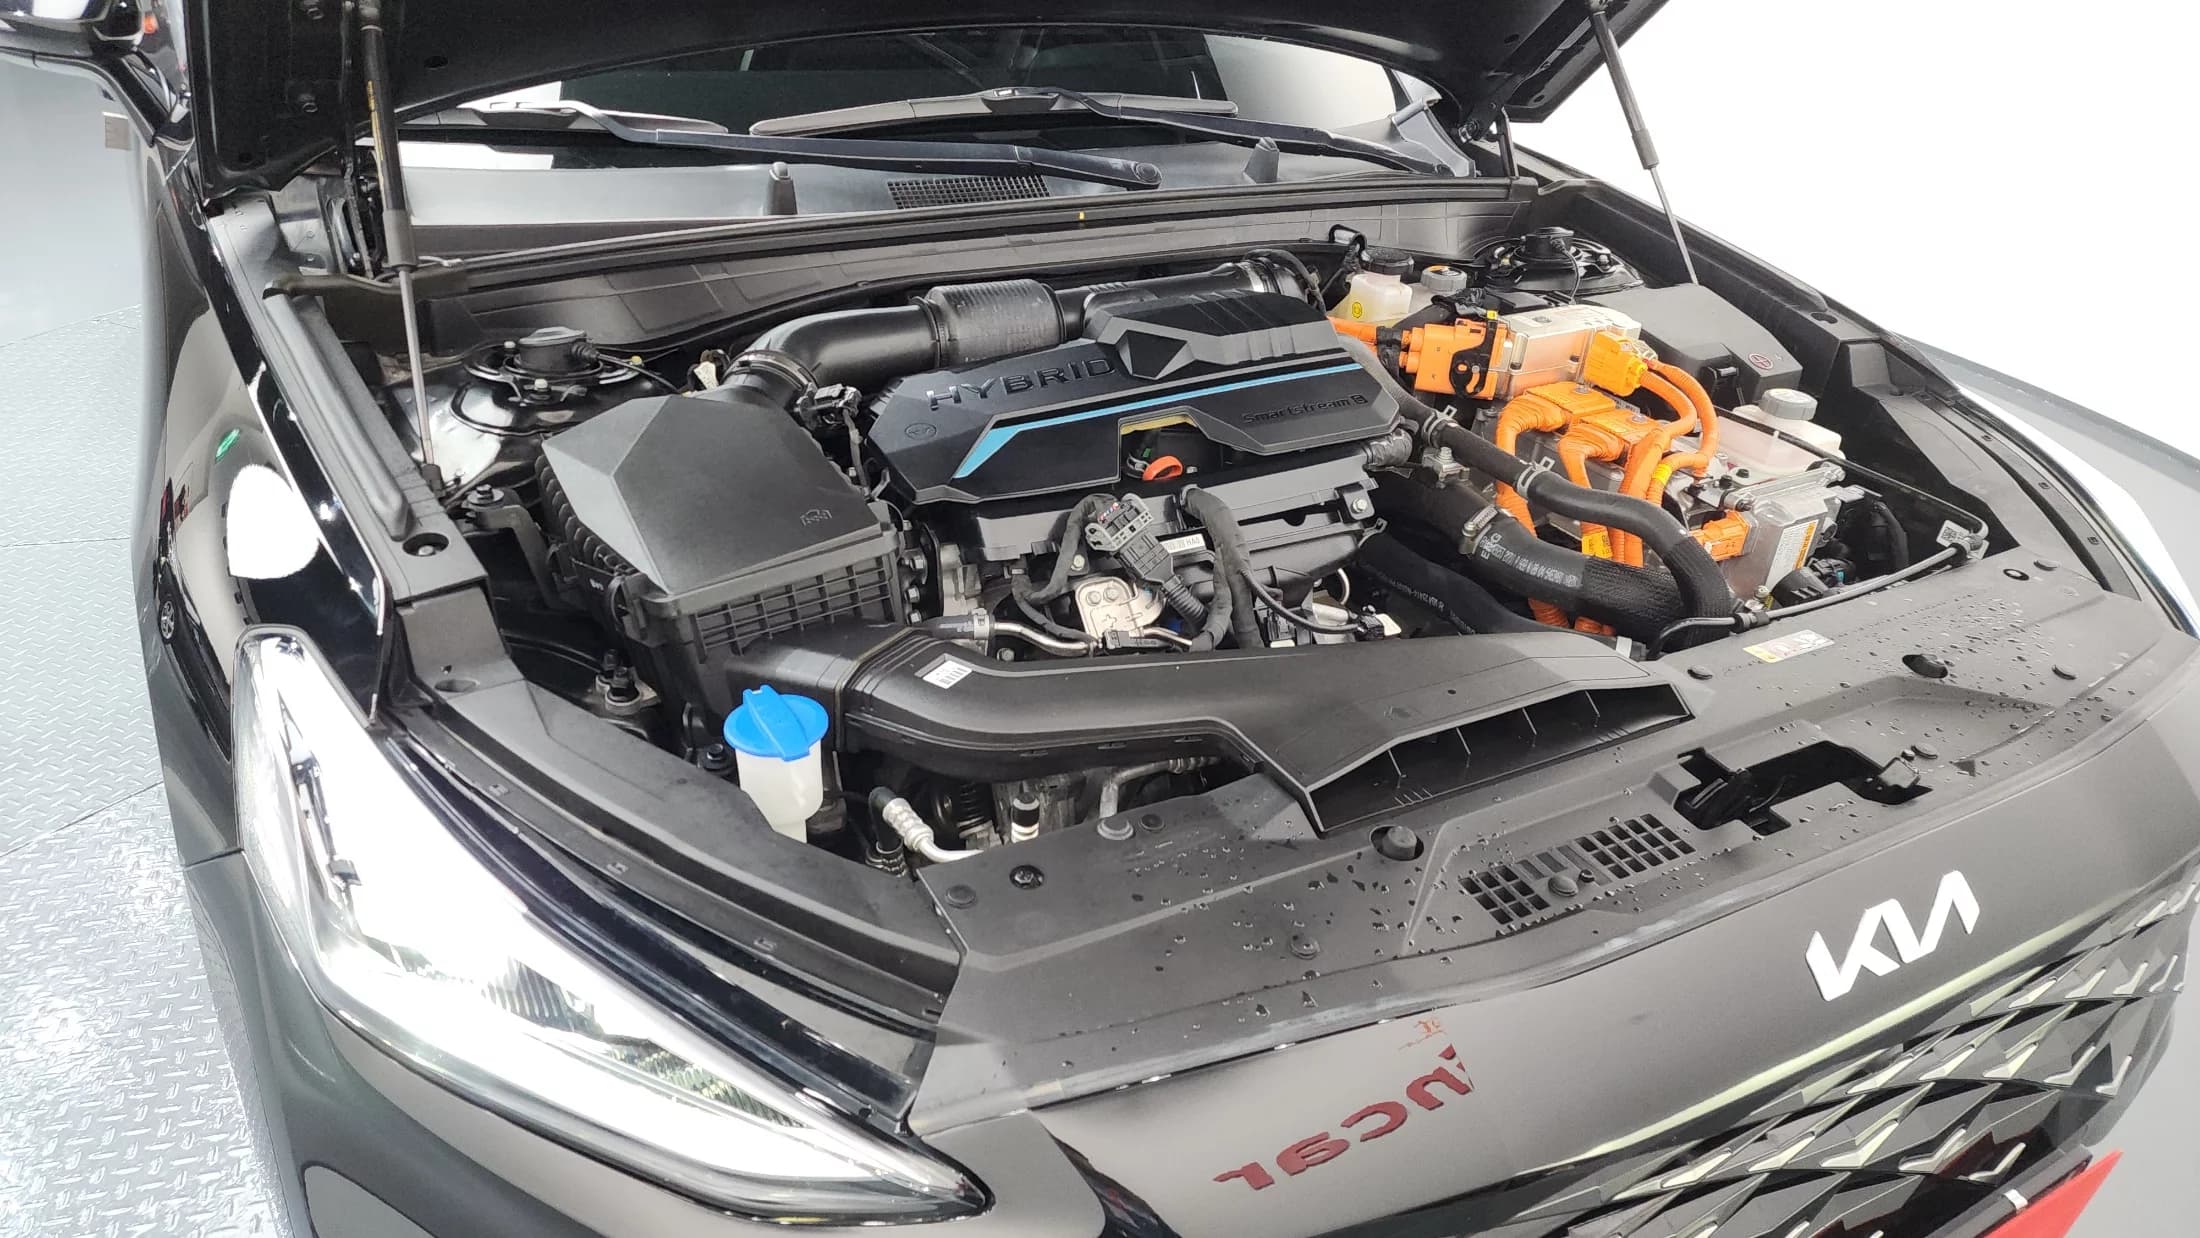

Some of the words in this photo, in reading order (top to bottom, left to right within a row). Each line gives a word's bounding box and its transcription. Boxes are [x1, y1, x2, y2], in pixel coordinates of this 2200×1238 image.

[926, 358, 1116, 411] HYBRID
[1242, 397, 1350, 425] Smartstream
[1805, 869, 1981, 1002] KIA
